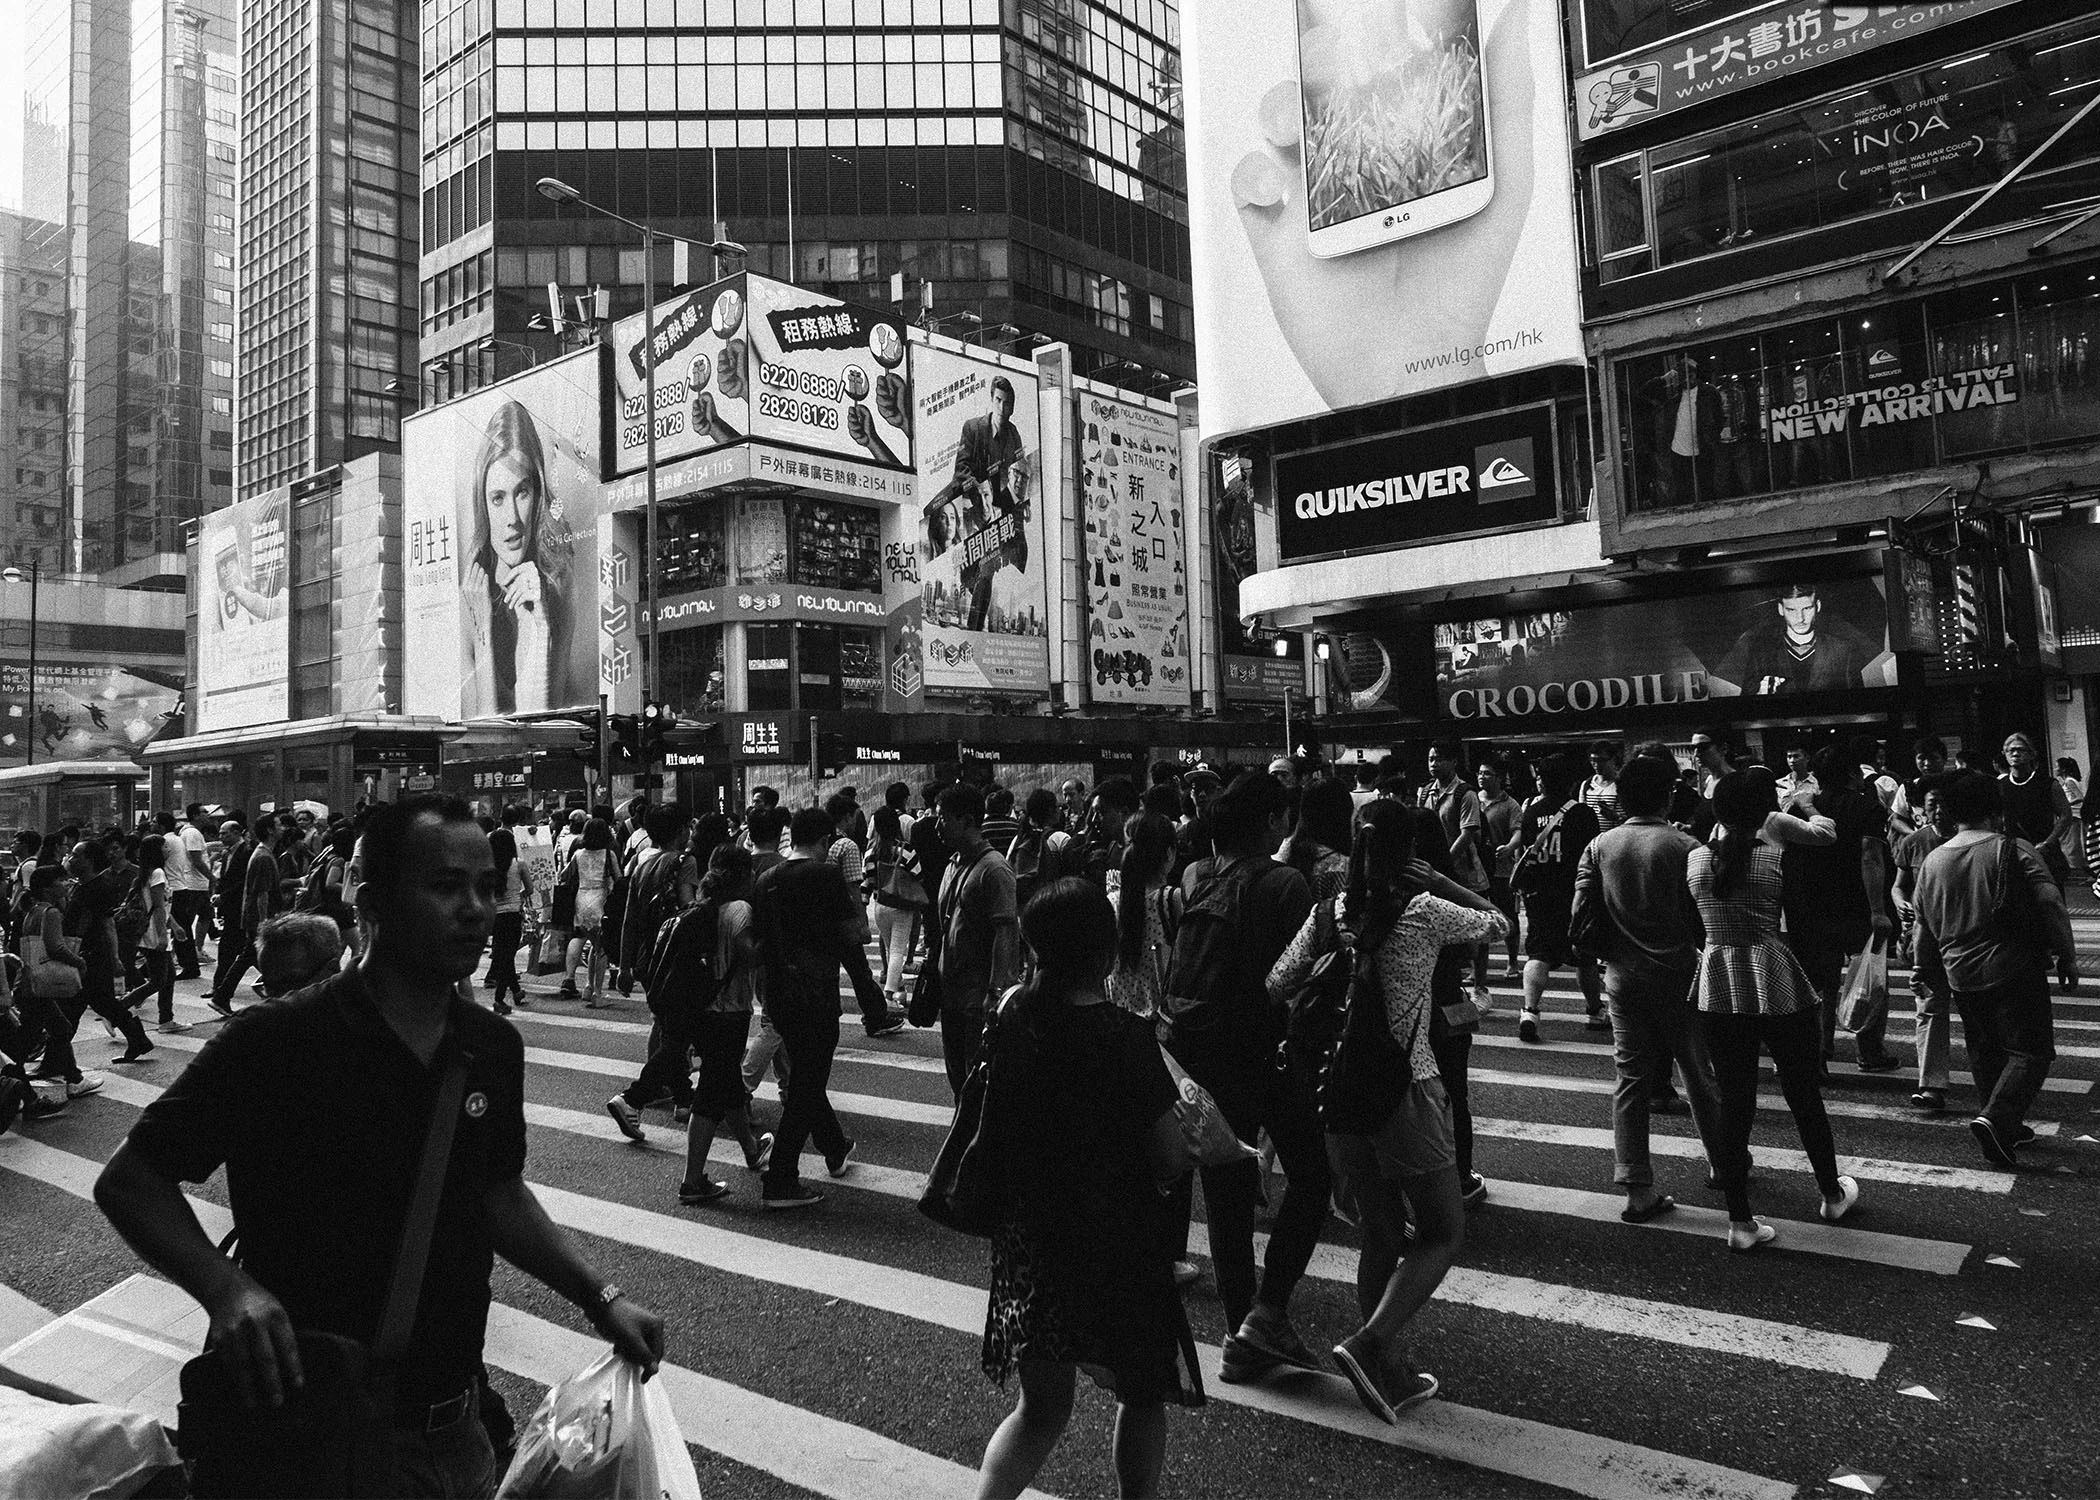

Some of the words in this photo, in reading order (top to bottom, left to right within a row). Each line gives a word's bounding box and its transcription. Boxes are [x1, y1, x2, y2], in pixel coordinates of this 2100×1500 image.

[1672, 8, 1822, 80] 十大書坊
[1675, 0, 1975, 98] www.bookcafe.com.
[1854, 104, 1887, 118] DISCOVER
[1855, 117, 1870, 127] THE
[1871, 107, 1902, 122] COLOR
[1905, 103, 1918, 112] OF
[1919, 93, 1950, 108] FUTURE
[1887, 157, 1907, 169] THERE
[1909, 152, 1926, 162] WAS
[1927, 148, 1944, 159] HAIR
[1910, 159, 1931, 170] THERE
[1931, 156, 1939, 164] IS
[1396, 212, 1411, 224] LG
[1404, 328, 1544, 375] www.lg.com/hk
[759, 361, 798, 391] 6220
[800, 370, 847, 403] 6888/
[1952, 364, 2015, 386] FALL
[759, 393, 798, 422] 2829
[800, 402, 839, 431] 8128
[1770, 382, 1915, 421] COLLECTION
[1772, 410, 1847, 443] NEW
[1859, 380, 2017, 428] ARRIVAL
[654, 411, 684, 440] 8128
[710, 457, 733, 477] 1115
[1122, 450, 1166, 472] ENTRANCE
[892, 479, 912, 496] 1115
[1295, 465, 1471, 520] QUIKSILVER
[563, 528, 597, 543] Collection
[1128, 473, 1150, 573] 新之城
[1150, 500, 1166, 561] 入口
[409, 514, 451, 569] 周生生
[2, 684, 15, 693] My
[1448, 670, 1711, 720] CROCODILE
[742, 722, 779, 745] 周生生
[742, 744, 755, 754] Chow
[755, 745, 767, 755] Sang
[767, 744, 779, 755] Sang
